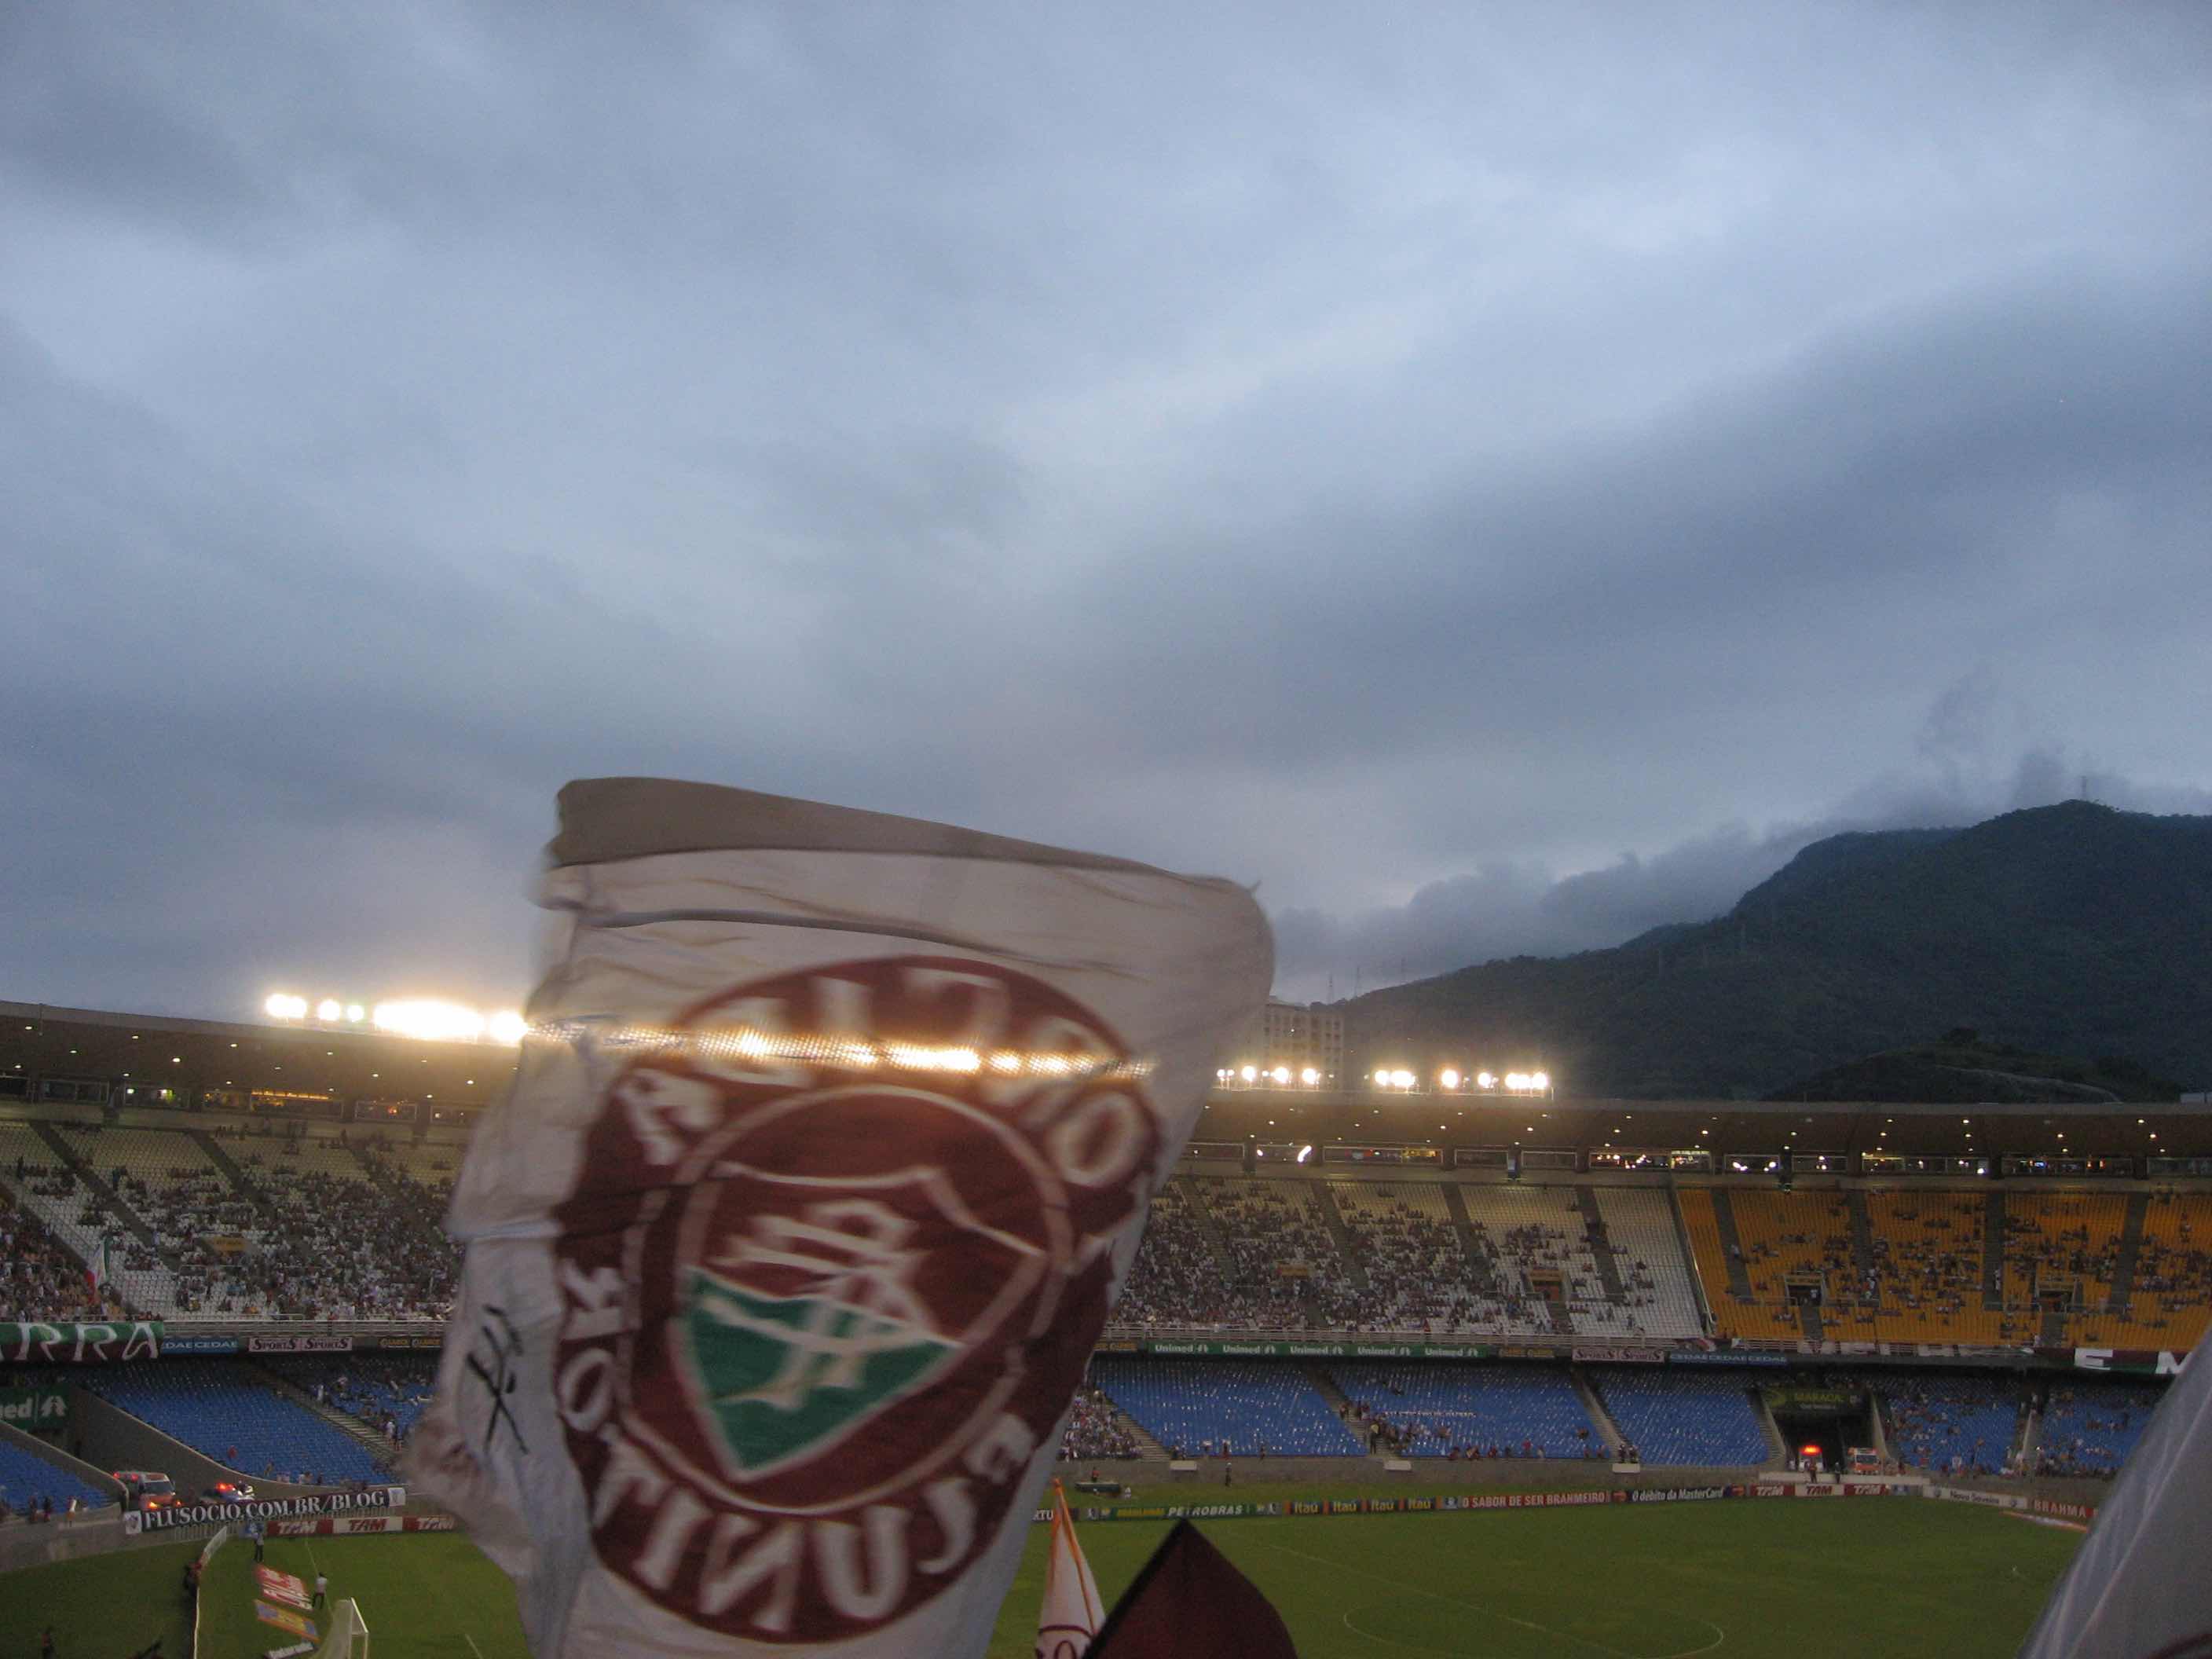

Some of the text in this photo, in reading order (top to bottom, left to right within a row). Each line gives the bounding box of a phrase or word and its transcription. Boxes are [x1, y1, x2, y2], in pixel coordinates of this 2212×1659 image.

[0, 1322, 159, 1361] RRA
[1155, 1343, 1193, 1353] Unimed
[1222, 1345, 1261, 1354] Unimed
[1290, 1346, 1328, 1355] Unimed
[1357, 1346, 1396, 1356] Unimed
[1425, 1347, 1463, 1357] Unimed
[1756, 1484, 1881, 1496] TAM TAM TAM
[1473, 1497, 1507, 1508] SABOR
[1509, 1496, 1522, 1507] DE
[1524, 1495, 1544, 1506] SER
[276, 1520, 318, 1534] TAM
[348, 1518, 389, 1533] TAM
